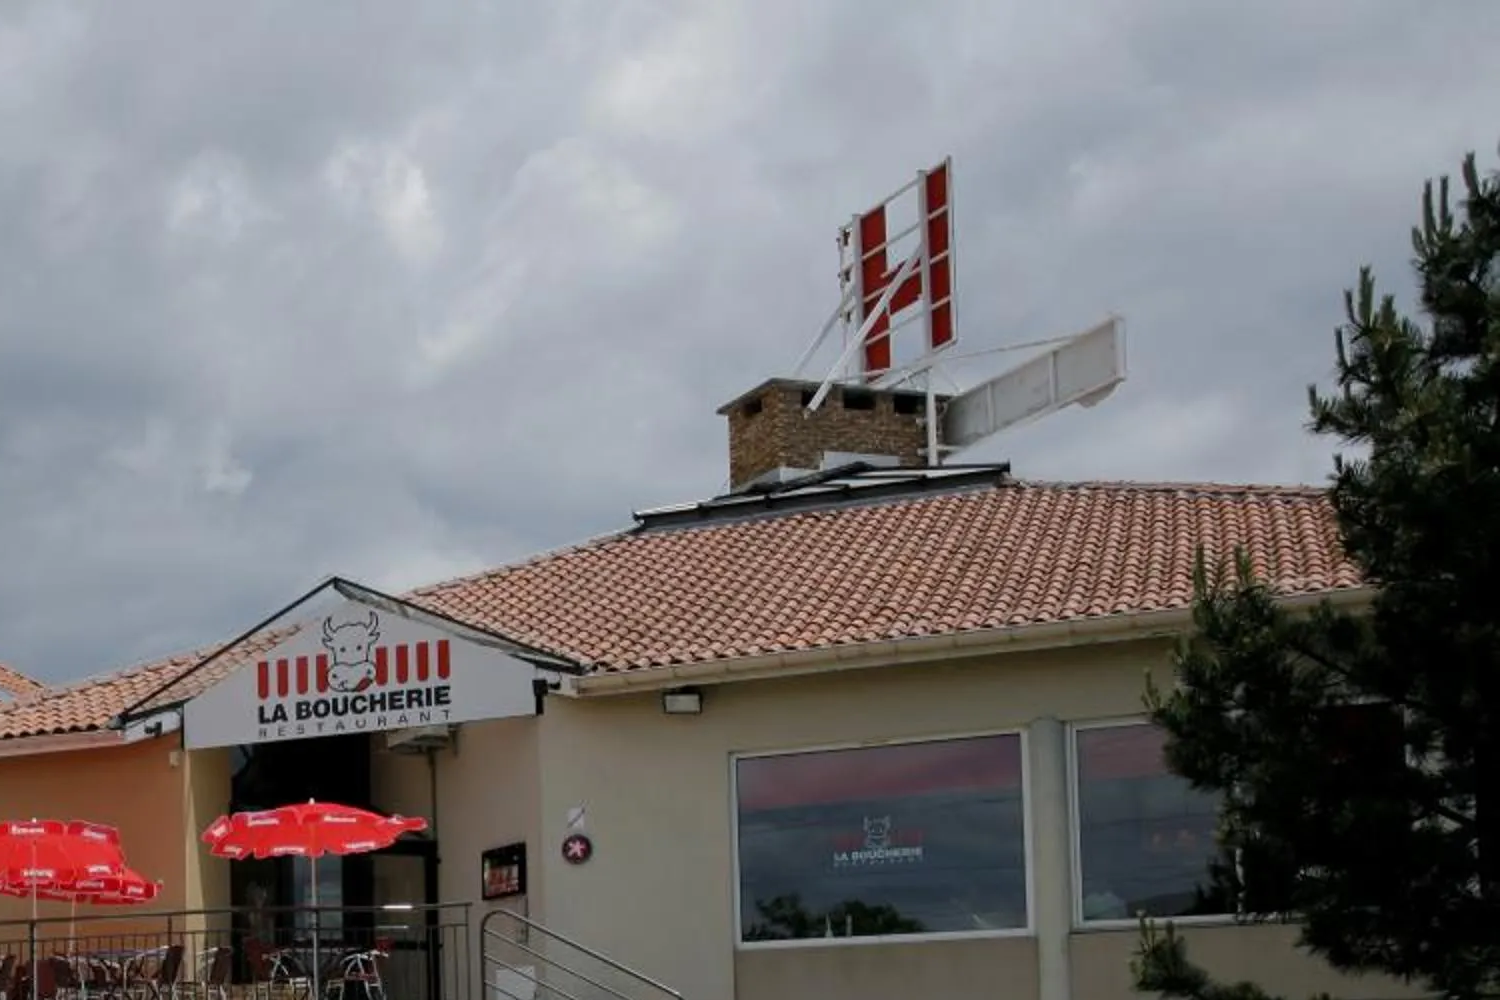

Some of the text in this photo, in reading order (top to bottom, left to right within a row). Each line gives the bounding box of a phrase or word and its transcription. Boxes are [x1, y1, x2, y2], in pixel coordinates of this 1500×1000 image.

[258, 686, 451, 725] LA BOUCHERIE
[258, 710, 451, 737] RESTAURANT
